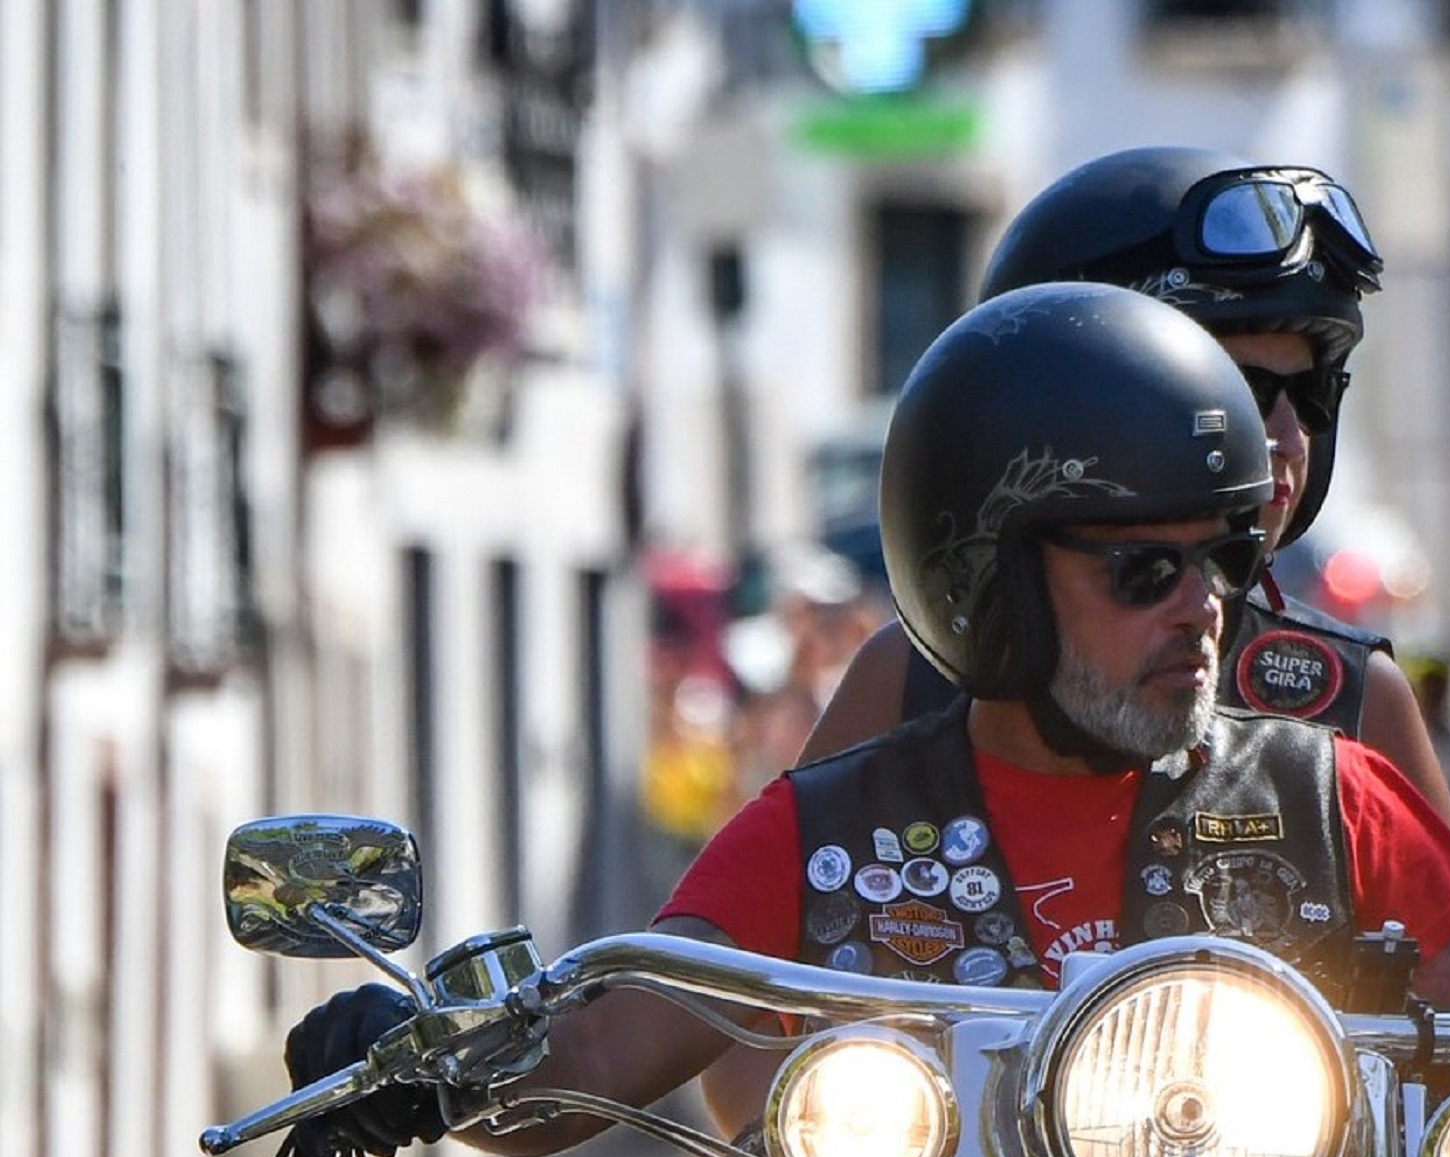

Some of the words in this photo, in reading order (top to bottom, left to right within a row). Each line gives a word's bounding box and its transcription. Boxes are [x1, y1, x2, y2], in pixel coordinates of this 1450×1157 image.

[1260, 651, 1323, 677] SUPER
[1265, 668, 1312, 691] GIRA
[966, 881, 985, 896] 81
[877, 918, 956, 941] HARLEY-DAVIDSON
